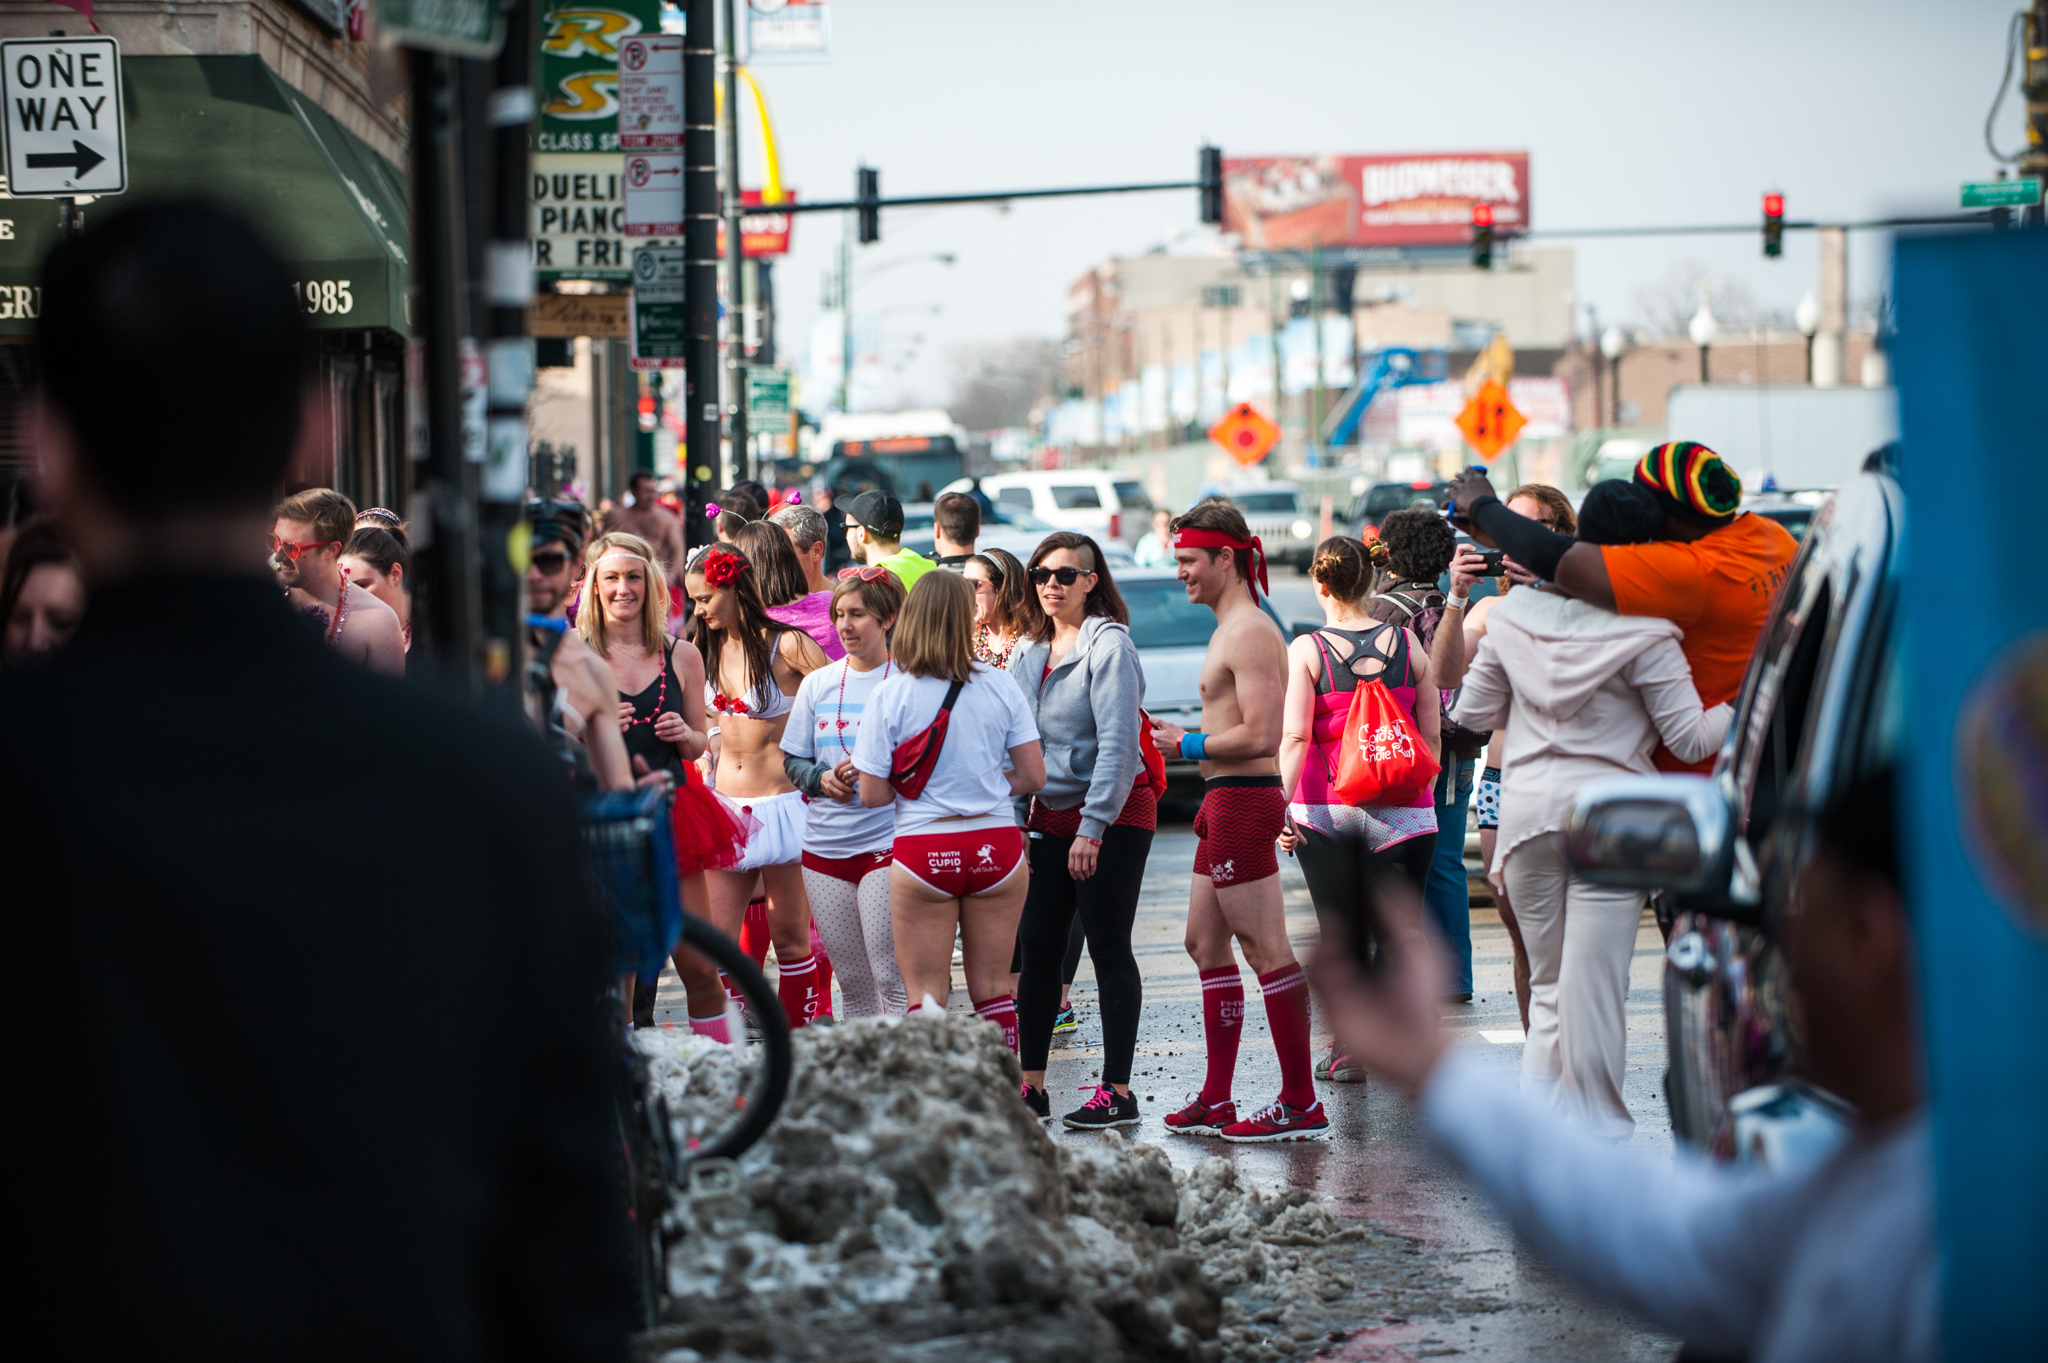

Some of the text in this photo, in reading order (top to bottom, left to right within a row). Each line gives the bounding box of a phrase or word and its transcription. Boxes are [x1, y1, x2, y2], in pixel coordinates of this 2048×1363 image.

[17, 53, 104, 89] ONE
[16, 95, 106, 132] WAY
[539, 132, 593, 150] CLASS
[1361, 159, 1519, 206] BUDWEISER
[576, 239, 622, 267] FRI
[928, 858, 961, 867] CUPID
